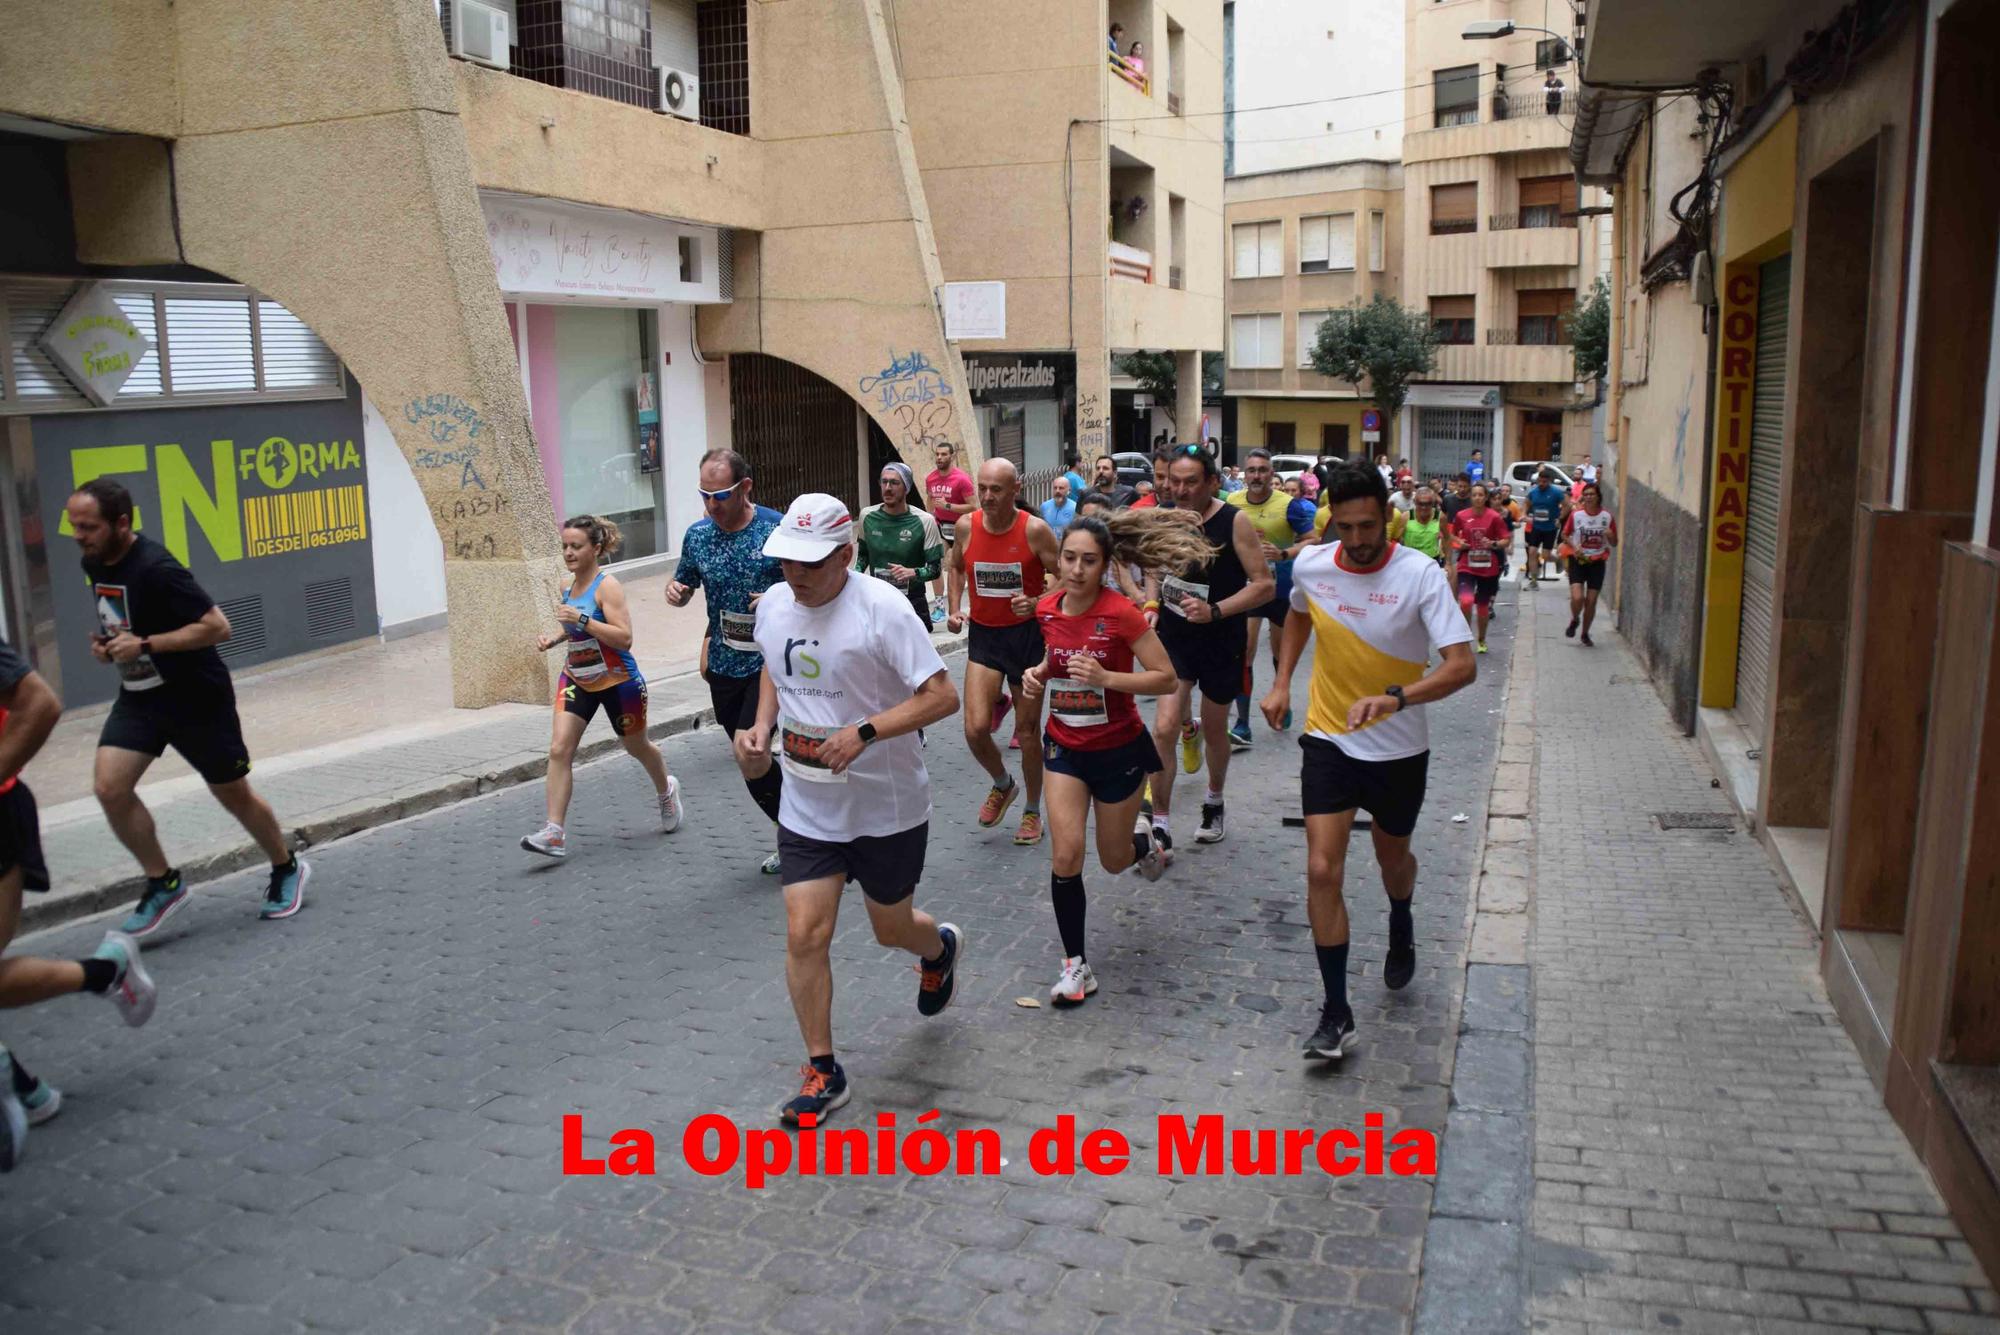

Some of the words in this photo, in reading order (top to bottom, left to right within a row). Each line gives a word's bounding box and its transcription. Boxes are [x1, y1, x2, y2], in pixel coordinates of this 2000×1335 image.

[963, 359, 1055, 397] Hipercalzados
[1715, 275, 1755, 553] CORTINAS
[239, 437, 361, 489] FORMA
[256, 533, 301, 557] DESDE
[310, 526, 359, 548] 061096
[1053, 647, 1107, 658] PUERAS
